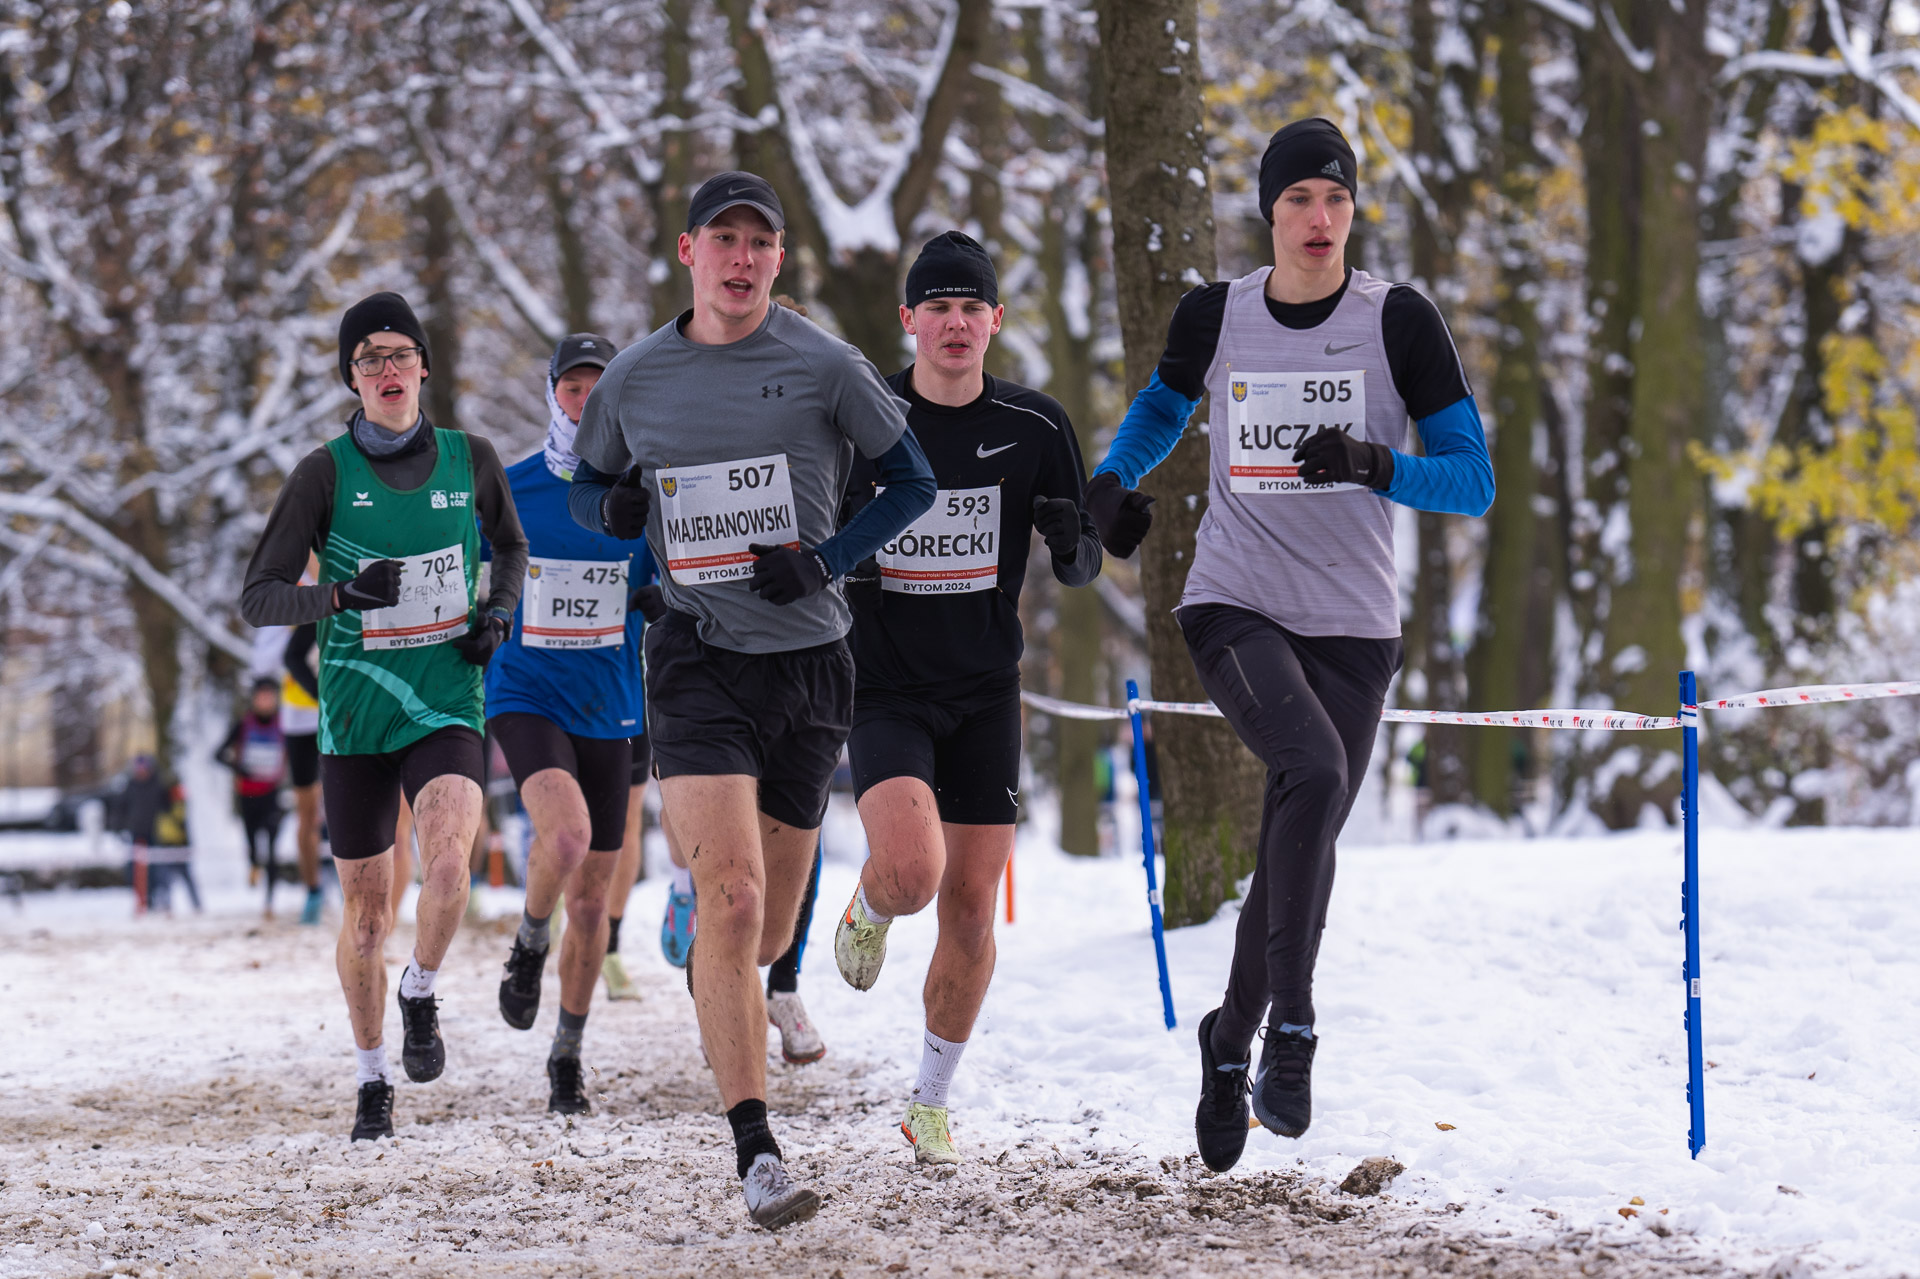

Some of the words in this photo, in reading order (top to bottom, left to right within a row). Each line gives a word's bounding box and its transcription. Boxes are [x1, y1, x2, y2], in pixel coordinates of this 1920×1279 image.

[1321, 168, 1344, 179] adidas
[1303, 380, 1352, 403] 505
[1239, 423, 1353, 450] ŁUCZ
[728, 464, 775, 491] 507
[1259, 481, 1301, 490] BYTOM
[946, 495, 990, 517] 593
[667, 504, 791, 544] MAJERANOWSKI
[881, 530, 994, 557] GÓRECKI
[422, 554, 456, 577] 702
[699, 568, 739, 580] BYTOM
[583, 568, 619, 585] 475
[903, 583, 943, 592] BYTOM
[945, 582, 971, 590] 2024
[552, 598, 599, 617] PISZ
[390, 636, 424, 646] BYTOM
[427, 632, 448, 642] 2024
[545, 639, 578, 647] BYTOM
